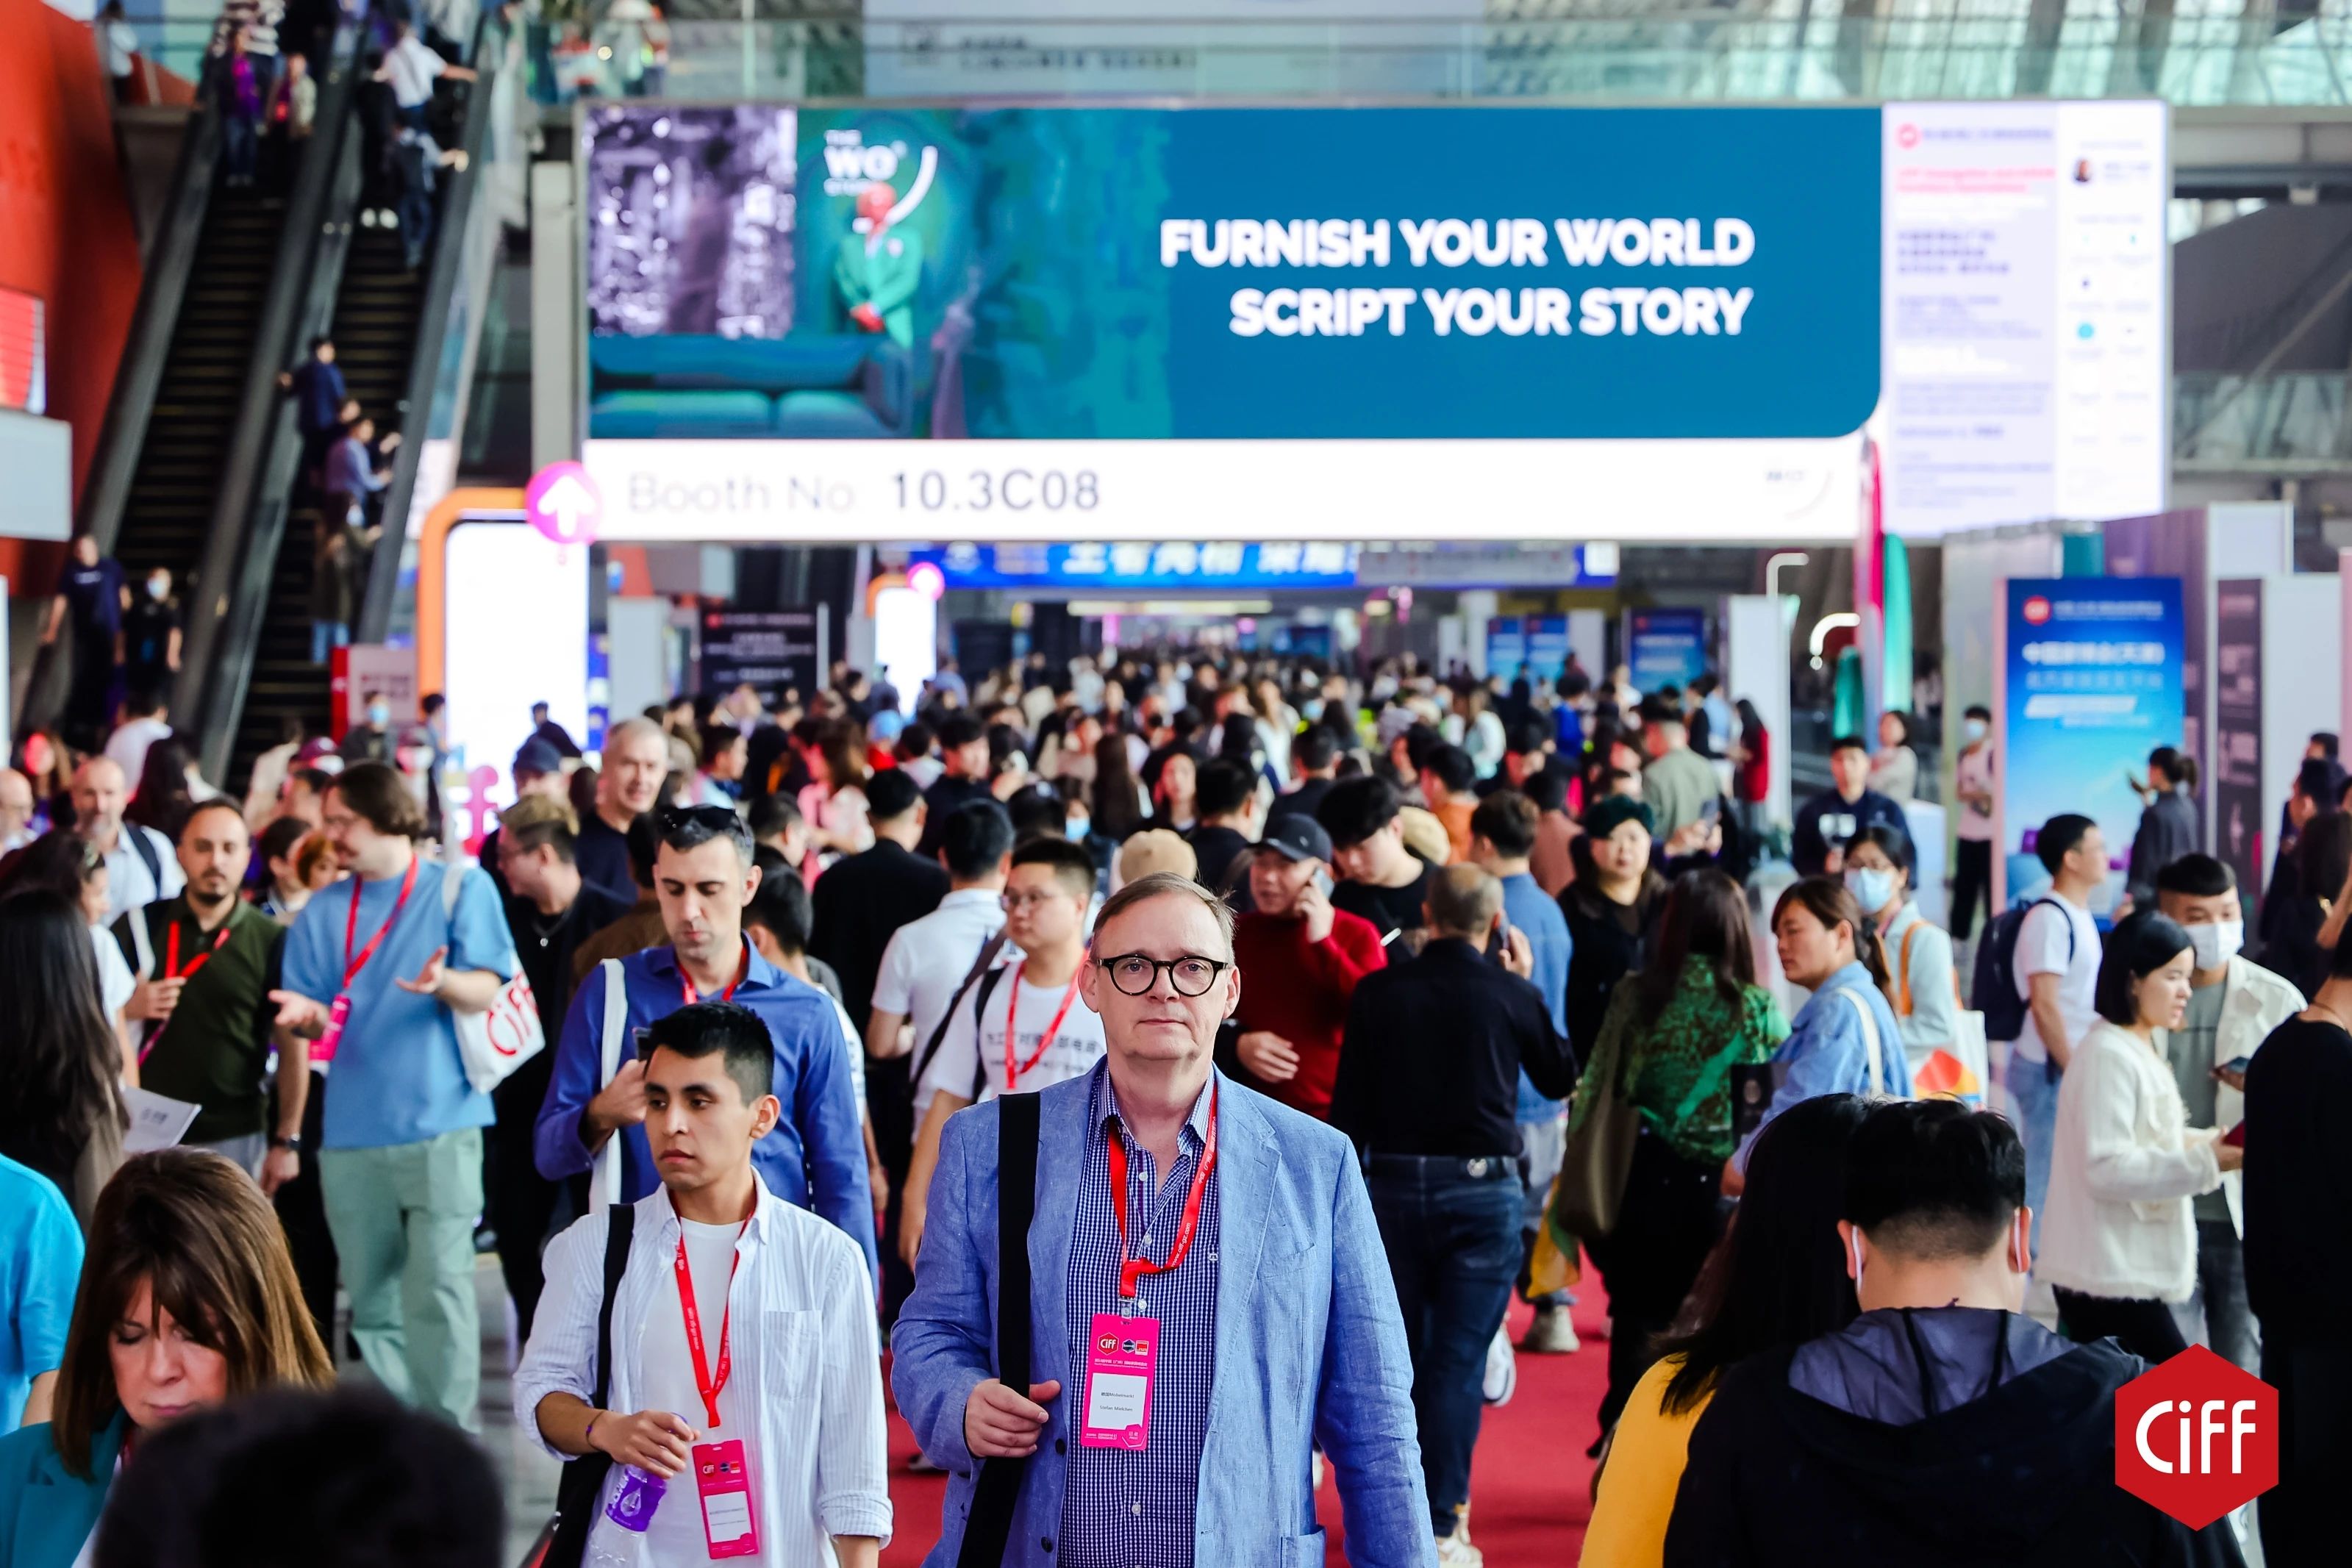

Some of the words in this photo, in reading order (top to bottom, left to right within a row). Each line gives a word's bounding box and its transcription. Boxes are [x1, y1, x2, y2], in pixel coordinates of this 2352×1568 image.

[1160, 218, 1390, 268] FURNISH
[1398, 218, 1548, 268] YOUR
[1555, 218, 1756, 268] WORLD
[1229, 287, 1418, 337] SCRIPT
[1422, 287, 1572, 337] YOUR
[1579, 287, 1755, 337] STORY
[626, 470, 771, 513] Booth
[890, 468, 1101, 512] 10.3C08
